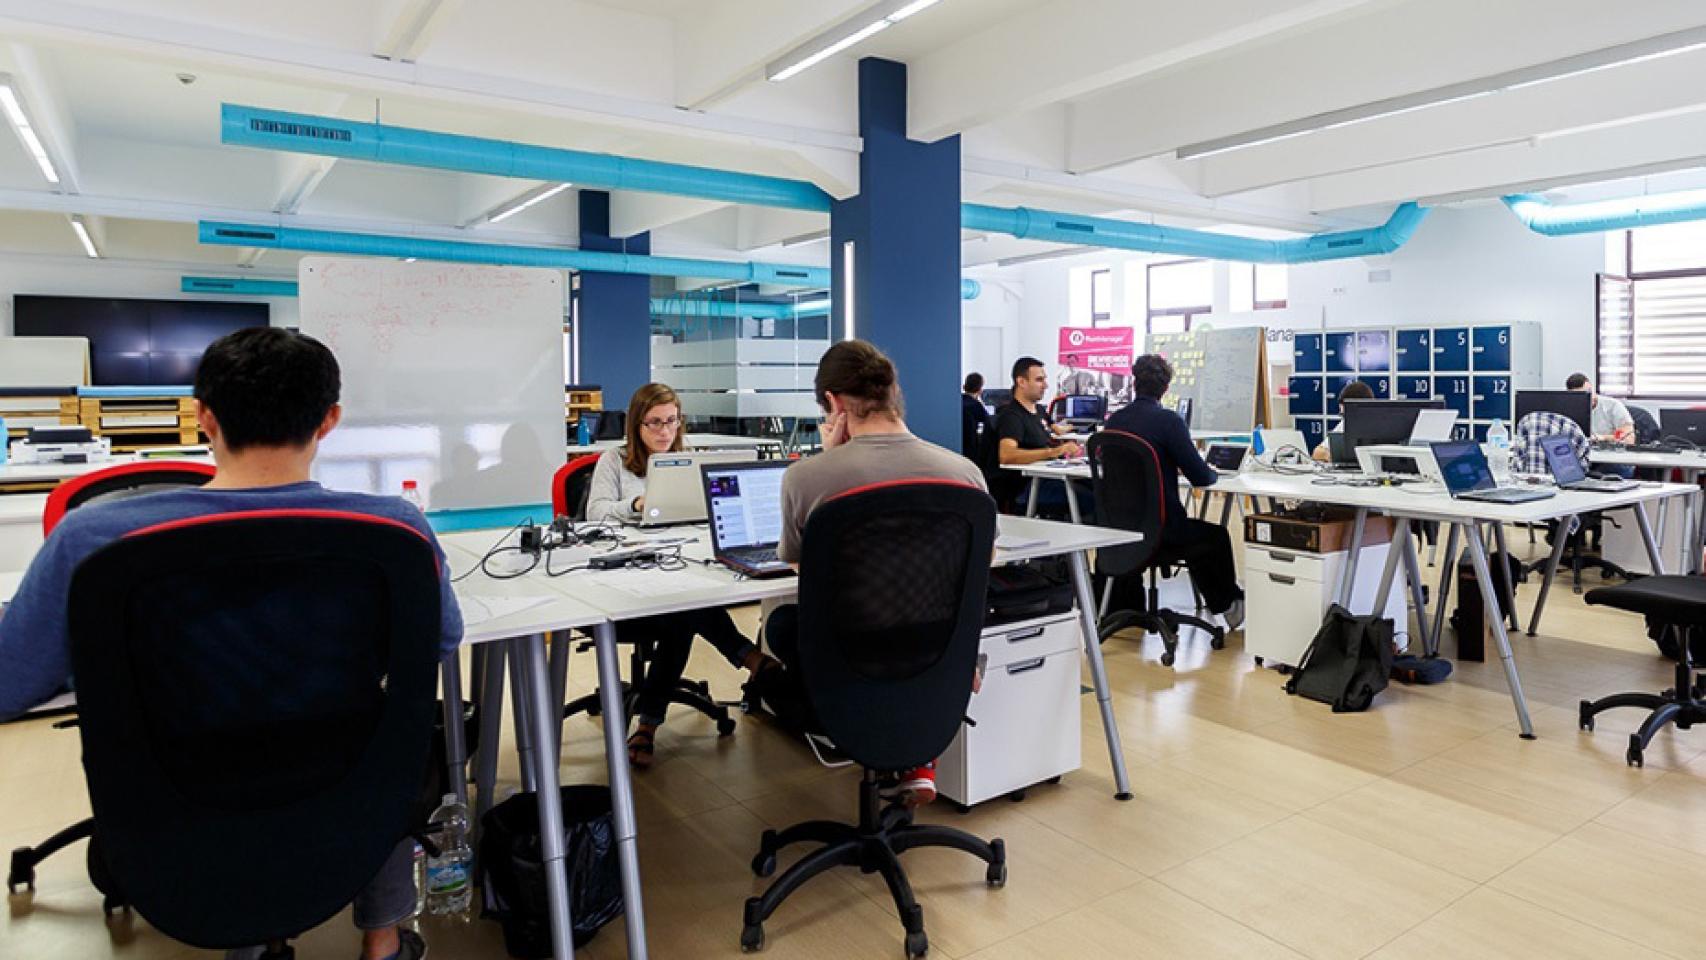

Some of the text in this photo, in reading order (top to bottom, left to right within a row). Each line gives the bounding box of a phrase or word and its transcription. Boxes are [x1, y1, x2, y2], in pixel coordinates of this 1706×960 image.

[1315, 337, 1320, 350] 1
[1345, 335, 1353, 347] 2
[1419, 333, 1428, 346] 4
[1457, 331, 1466, 346] 5
[1498, 329, 1507, 345] 6
[1312, 379, 1320, 392] 7
[1379, 379, 1388, 393] 9
[1415, 379, 1428, 393] 10
[1453, 379, 1466, 394] 11
[1492, 379, 1507, 394] 12
[1311, 421, 1322, 434] 13
